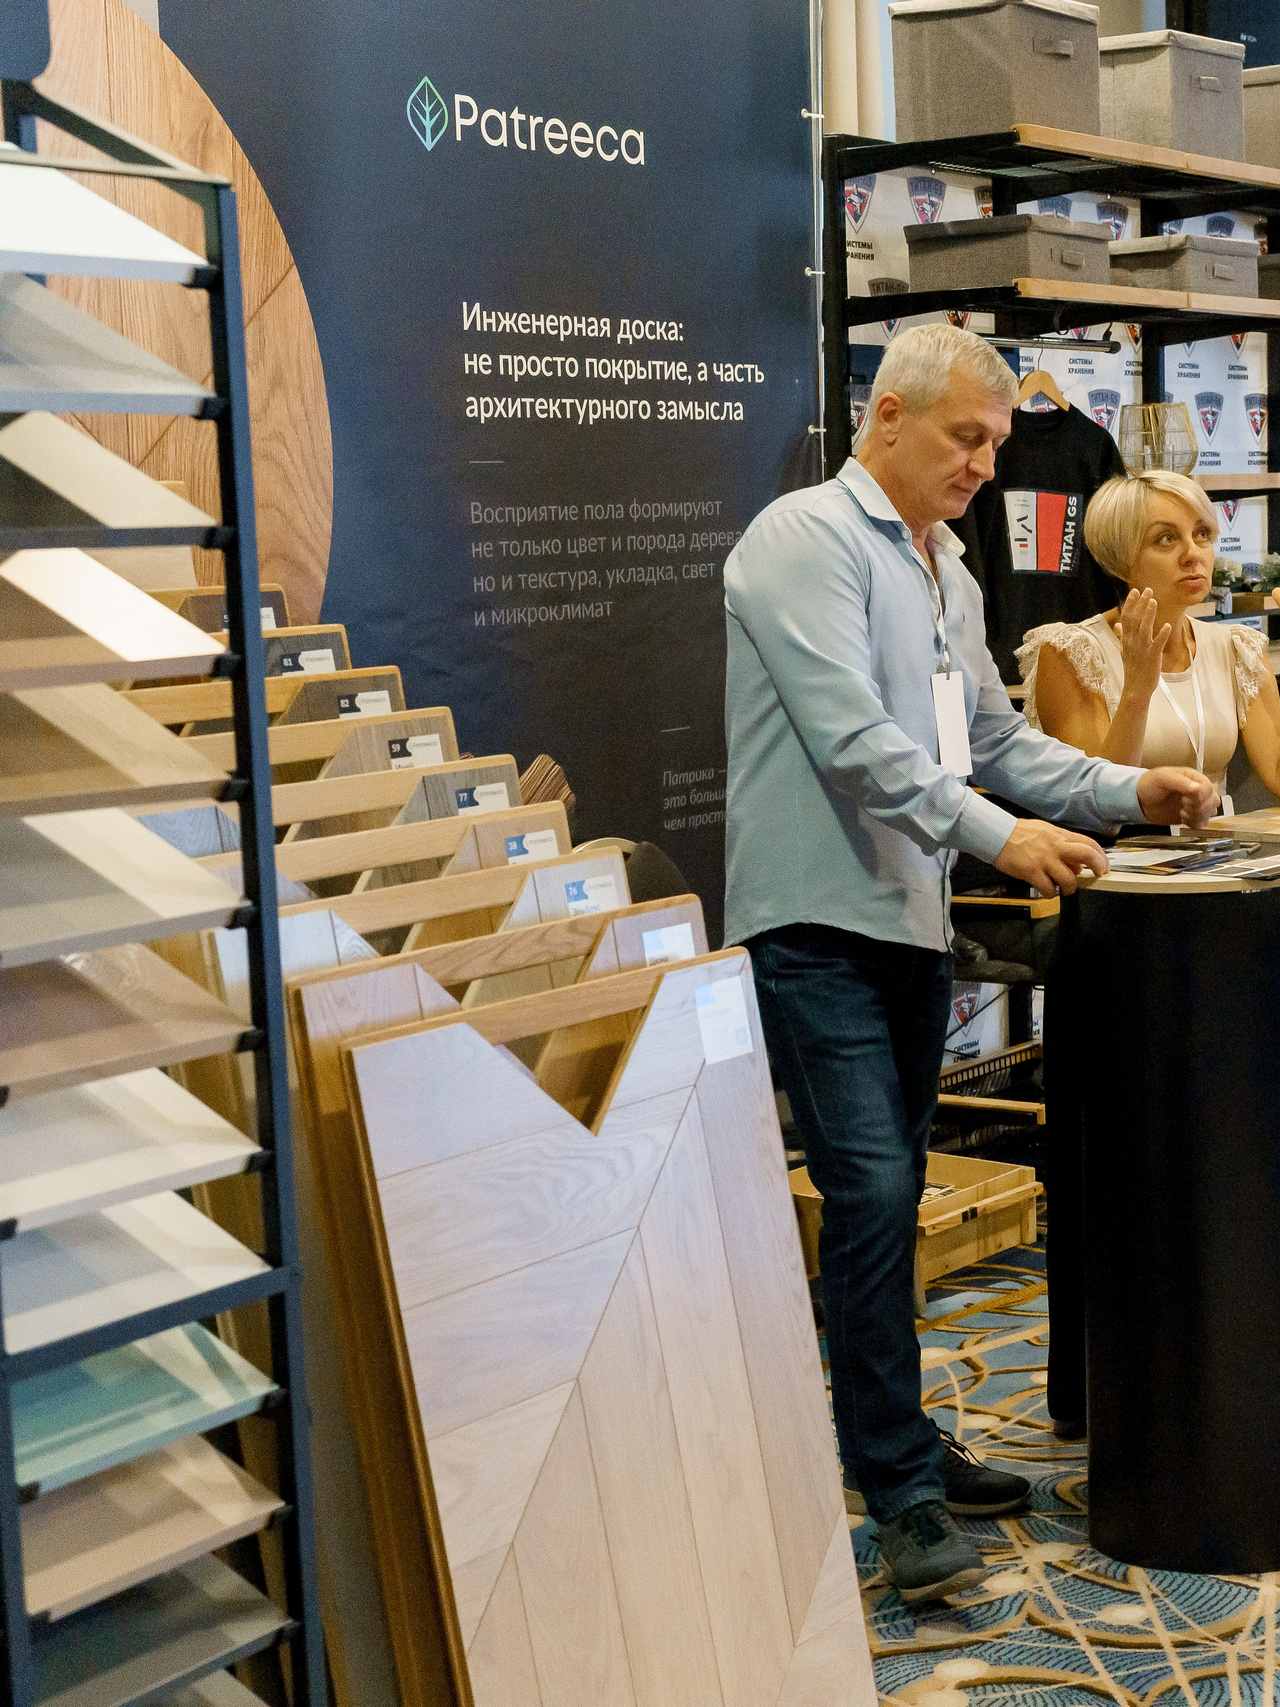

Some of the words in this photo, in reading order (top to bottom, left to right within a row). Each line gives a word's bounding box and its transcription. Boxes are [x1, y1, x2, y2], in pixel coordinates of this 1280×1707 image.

[454, 93, 645, 166] Patreeca
[846, 240, 873, 250] ИСТЕМЫ
[846, 252, 875, 261] РАНЕНИЯ
[462, 301, 611, 342] Инженерная
[617, 317, 685, 344] доска:
[464, 352, 492, 375] не
[499, 354, 579, 382] просто
[585, 358, 693, 385] покрытие,
[697, 363, 708, 381] а
[712, 361, 765, 384] часть
[1067, 367, 1095, 375] ХРАНЕНИЯ
[1068, 358, 1093, 366] СИСТЕМЫ
[465, 393, 652, 426] архитектурного
[657, 397, 744, 421] замысла
[470, 500, 579, 525] Восприятие
[584, 502, 624, 521] пола
[628, 497, 723, 522] формируют
[1067, 496, 1078, 518] GS
[472, 539, 494, 559] не
[499, 536, 562, 558] только
[566, 534, 608, 557] цвет
[612, 533, 622, 551] и
[626, 530, 687, 554] порода
[1060, 521, 1076, 573] ТИТАН
[473, 574, 496, 593] но
[501, 572, 513, 591] и
[518, 567, 602, 592] текстура,
[606, 565, 679, 588] укладка,
[681, 561, 716, 580] свет
[474, 609, 486, 627] и
[490, 600, 614, 628] микроклимат
[663, 768, 715, 787] Патрика
[663, 795, 687, 810] это
[689, 788, 727, 805] больш
[663, 816, 686, 831] чем
